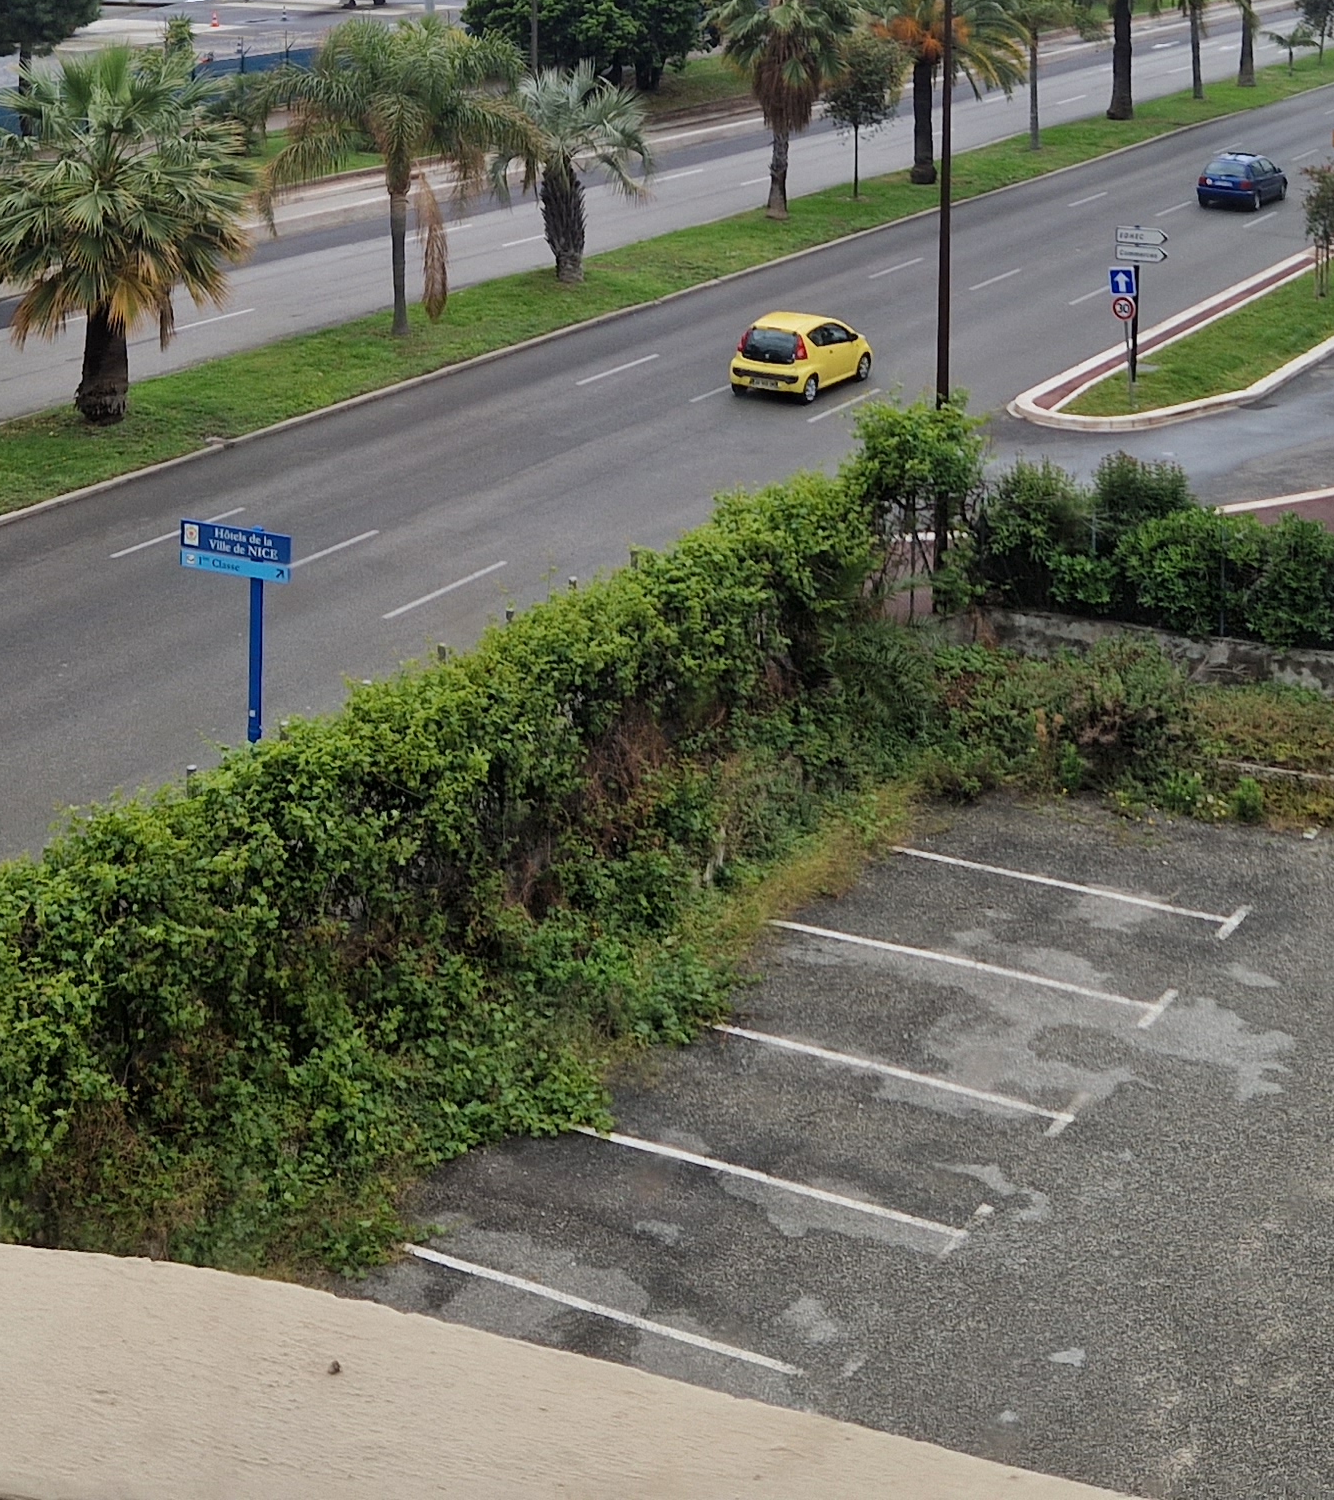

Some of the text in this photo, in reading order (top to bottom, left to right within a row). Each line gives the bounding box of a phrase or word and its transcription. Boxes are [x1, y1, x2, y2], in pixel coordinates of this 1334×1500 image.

[1117, 302, 1130, 314] 30
[214, 527, 273, 547] Hôtels de la
[209, 539, 279, 561] Ville de NICE
[211, 558, 241, 572] Classe
